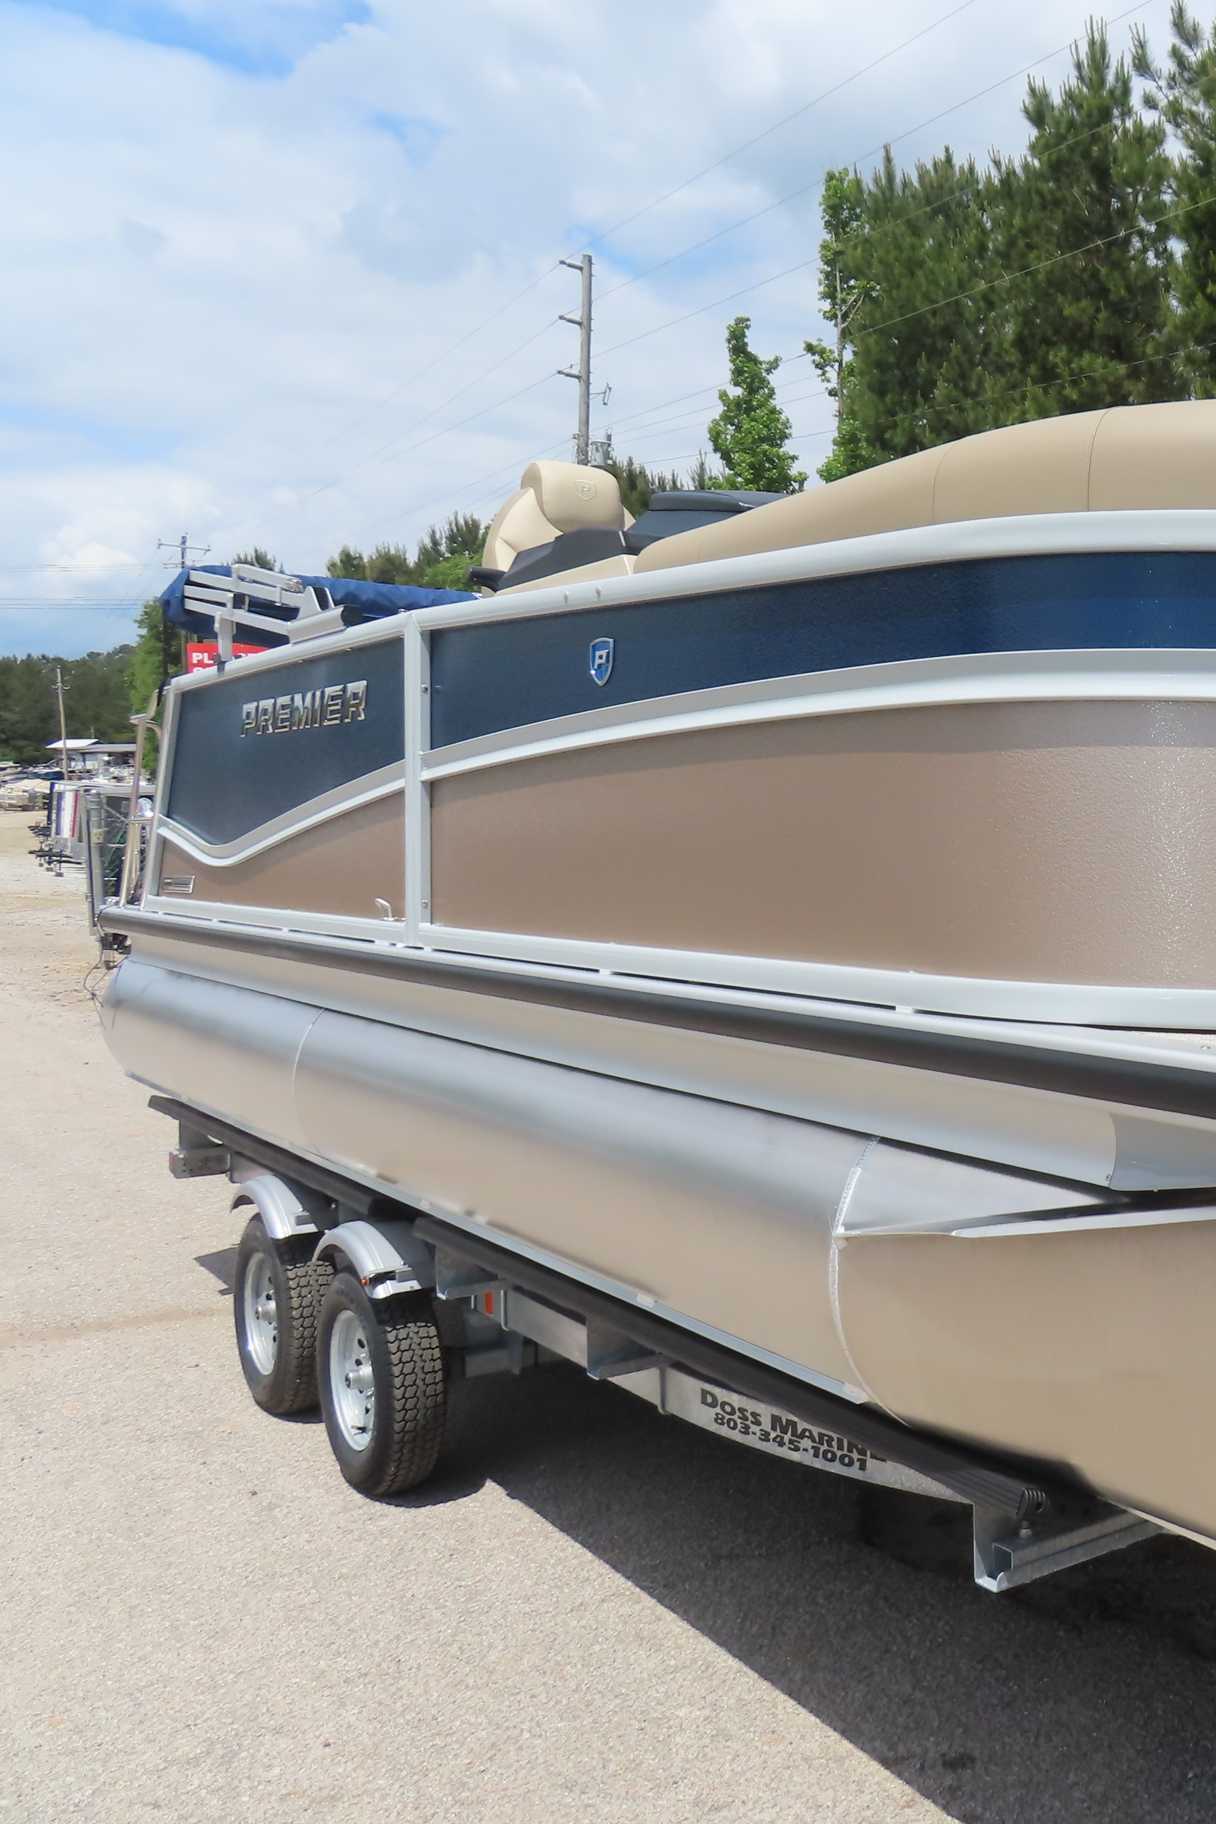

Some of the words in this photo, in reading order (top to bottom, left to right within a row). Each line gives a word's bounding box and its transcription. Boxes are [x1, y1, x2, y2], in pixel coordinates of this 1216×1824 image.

[239, 680, 368, 738] PREMIER
[713, 1412, 868, 1471] 803-345-1001
[770, 1413, 887, 1463] MARIN
